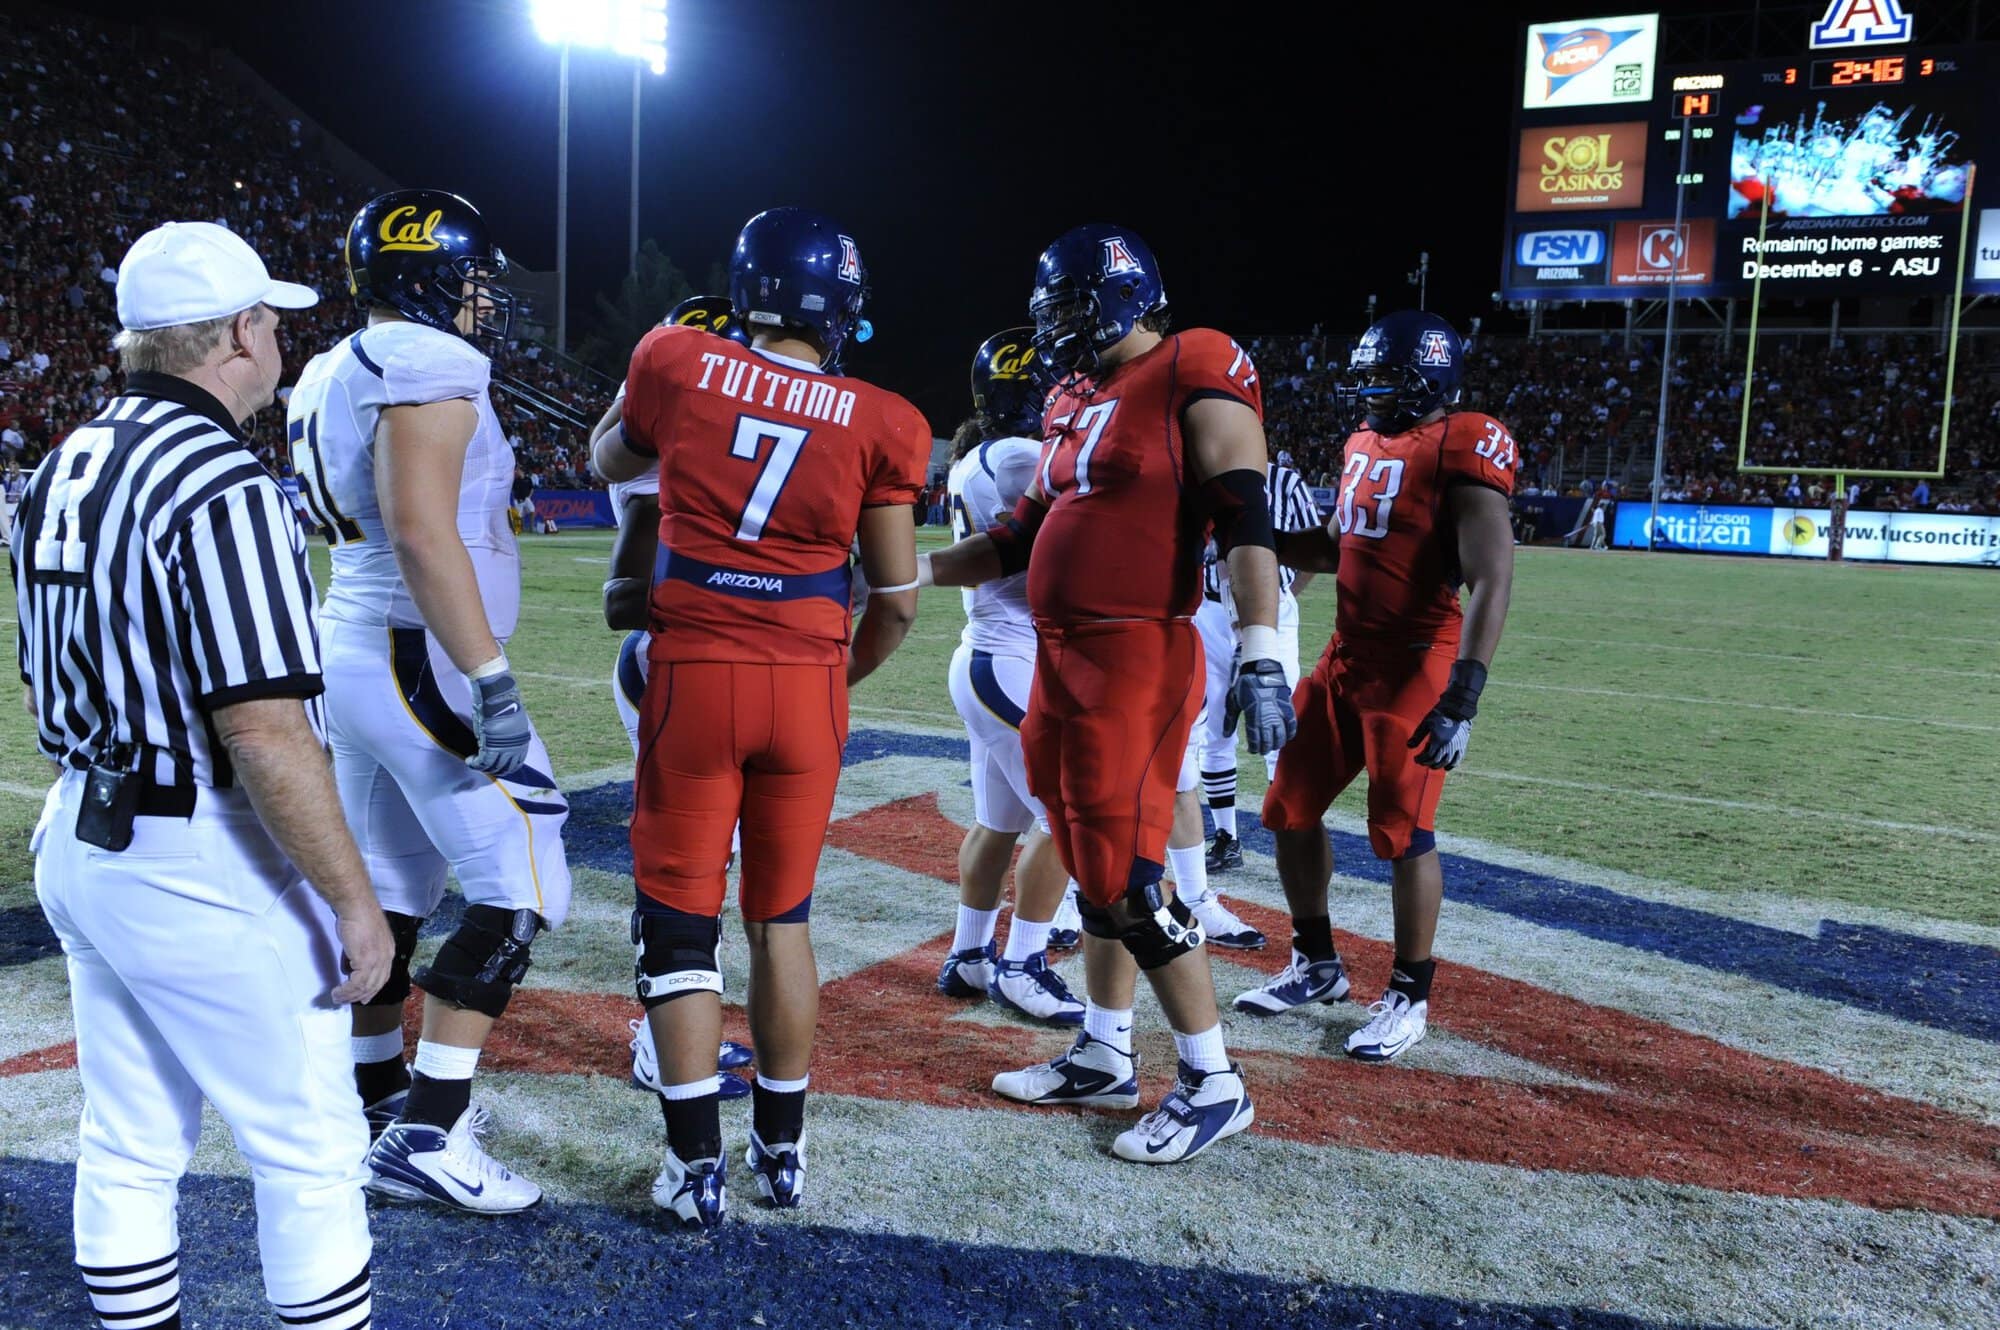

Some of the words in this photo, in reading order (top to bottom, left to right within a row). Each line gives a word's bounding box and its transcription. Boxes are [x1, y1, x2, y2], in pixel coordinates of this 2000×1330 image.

[1762, 72, 1783, 83] TOL
[1784, 68, 1797, 84] 3
[1831, 57, 1905, 85] 2:46
[1920, 59, 1934, 75] 3
[1936, 60, 1957, 72] TOL
[1683, 94, 1710, 116] 14
[1543, 134, 1623, 176] SOL
[1539, 173, 1623, 192] CASINOS
[379, 205, 442, 252] Cal
[1780, 216, 1929, 230] ARIZONAATHLETICS.COM
[1099, 236, 1145, 278] A
[1529, 234, 1591, 260] FSN
[1743, 236, 1831, 254] Remaining
[1831, 235, 1881, 250] home
[1881, 236, 1943, 253] games:
[837, 234, 861, 285] A
[1743, 259, 1845, 279] December
[1848, 259, 1863, 276] 6
[1890, 257, 1940, 276] ASU
[774, 278, 781, 291] 7
[1536, 267, 1580, 280] ARIZONA
[678, 309, 728, 332] Cl
[989, 344, 1036, 380] Cal
[1419, 330, 1451, 367] A
[697, 352, 857, 427] TUITAMA
[1474, 421, 1514, 470] 33
[729, 413, 812, 541] 7
[34, 427, 115, 573] R
[1337, 452, 1406, 539] 33
[1643, 515, 1751, 545] Citizen
[1696, 509, 1750, 525] Tucson
[706, 570, 783, 594] ARIZONA
